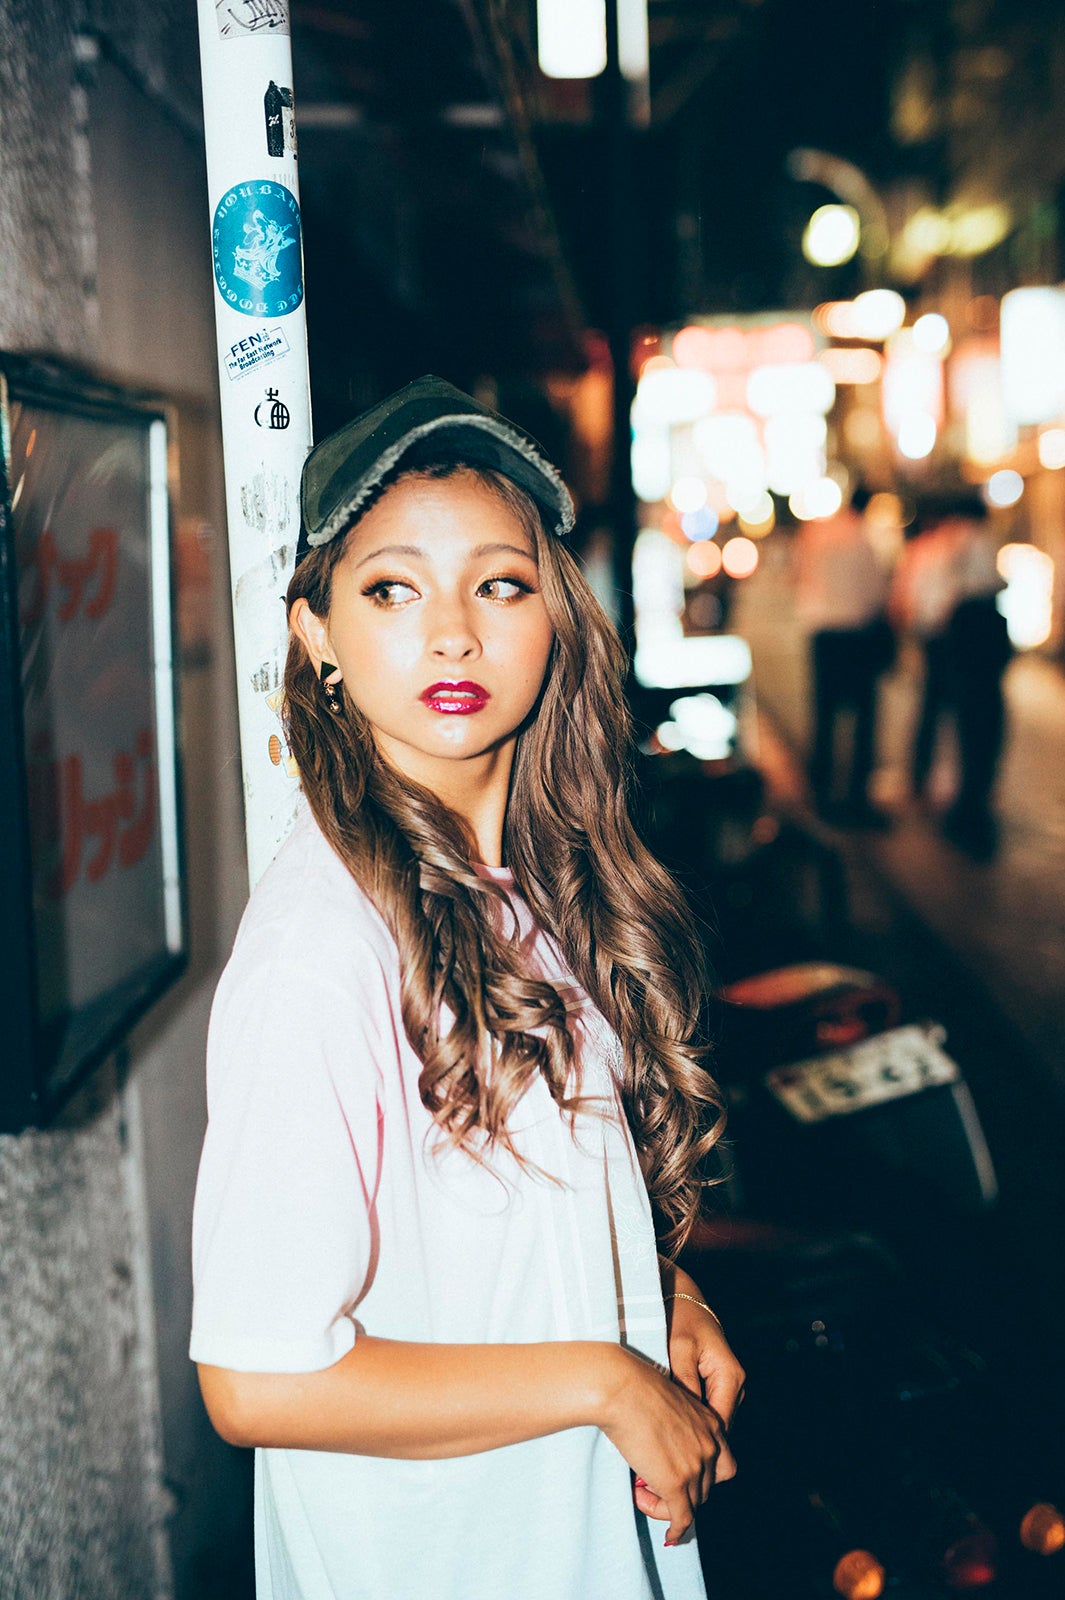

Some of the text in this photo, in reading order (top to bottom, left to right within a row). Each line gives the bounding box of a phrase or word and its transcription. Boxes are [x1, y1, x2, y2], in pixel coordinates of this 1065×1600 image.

[228, 337, 282, 370] The Far East Network
[230, 332, 262, 357] FEN
